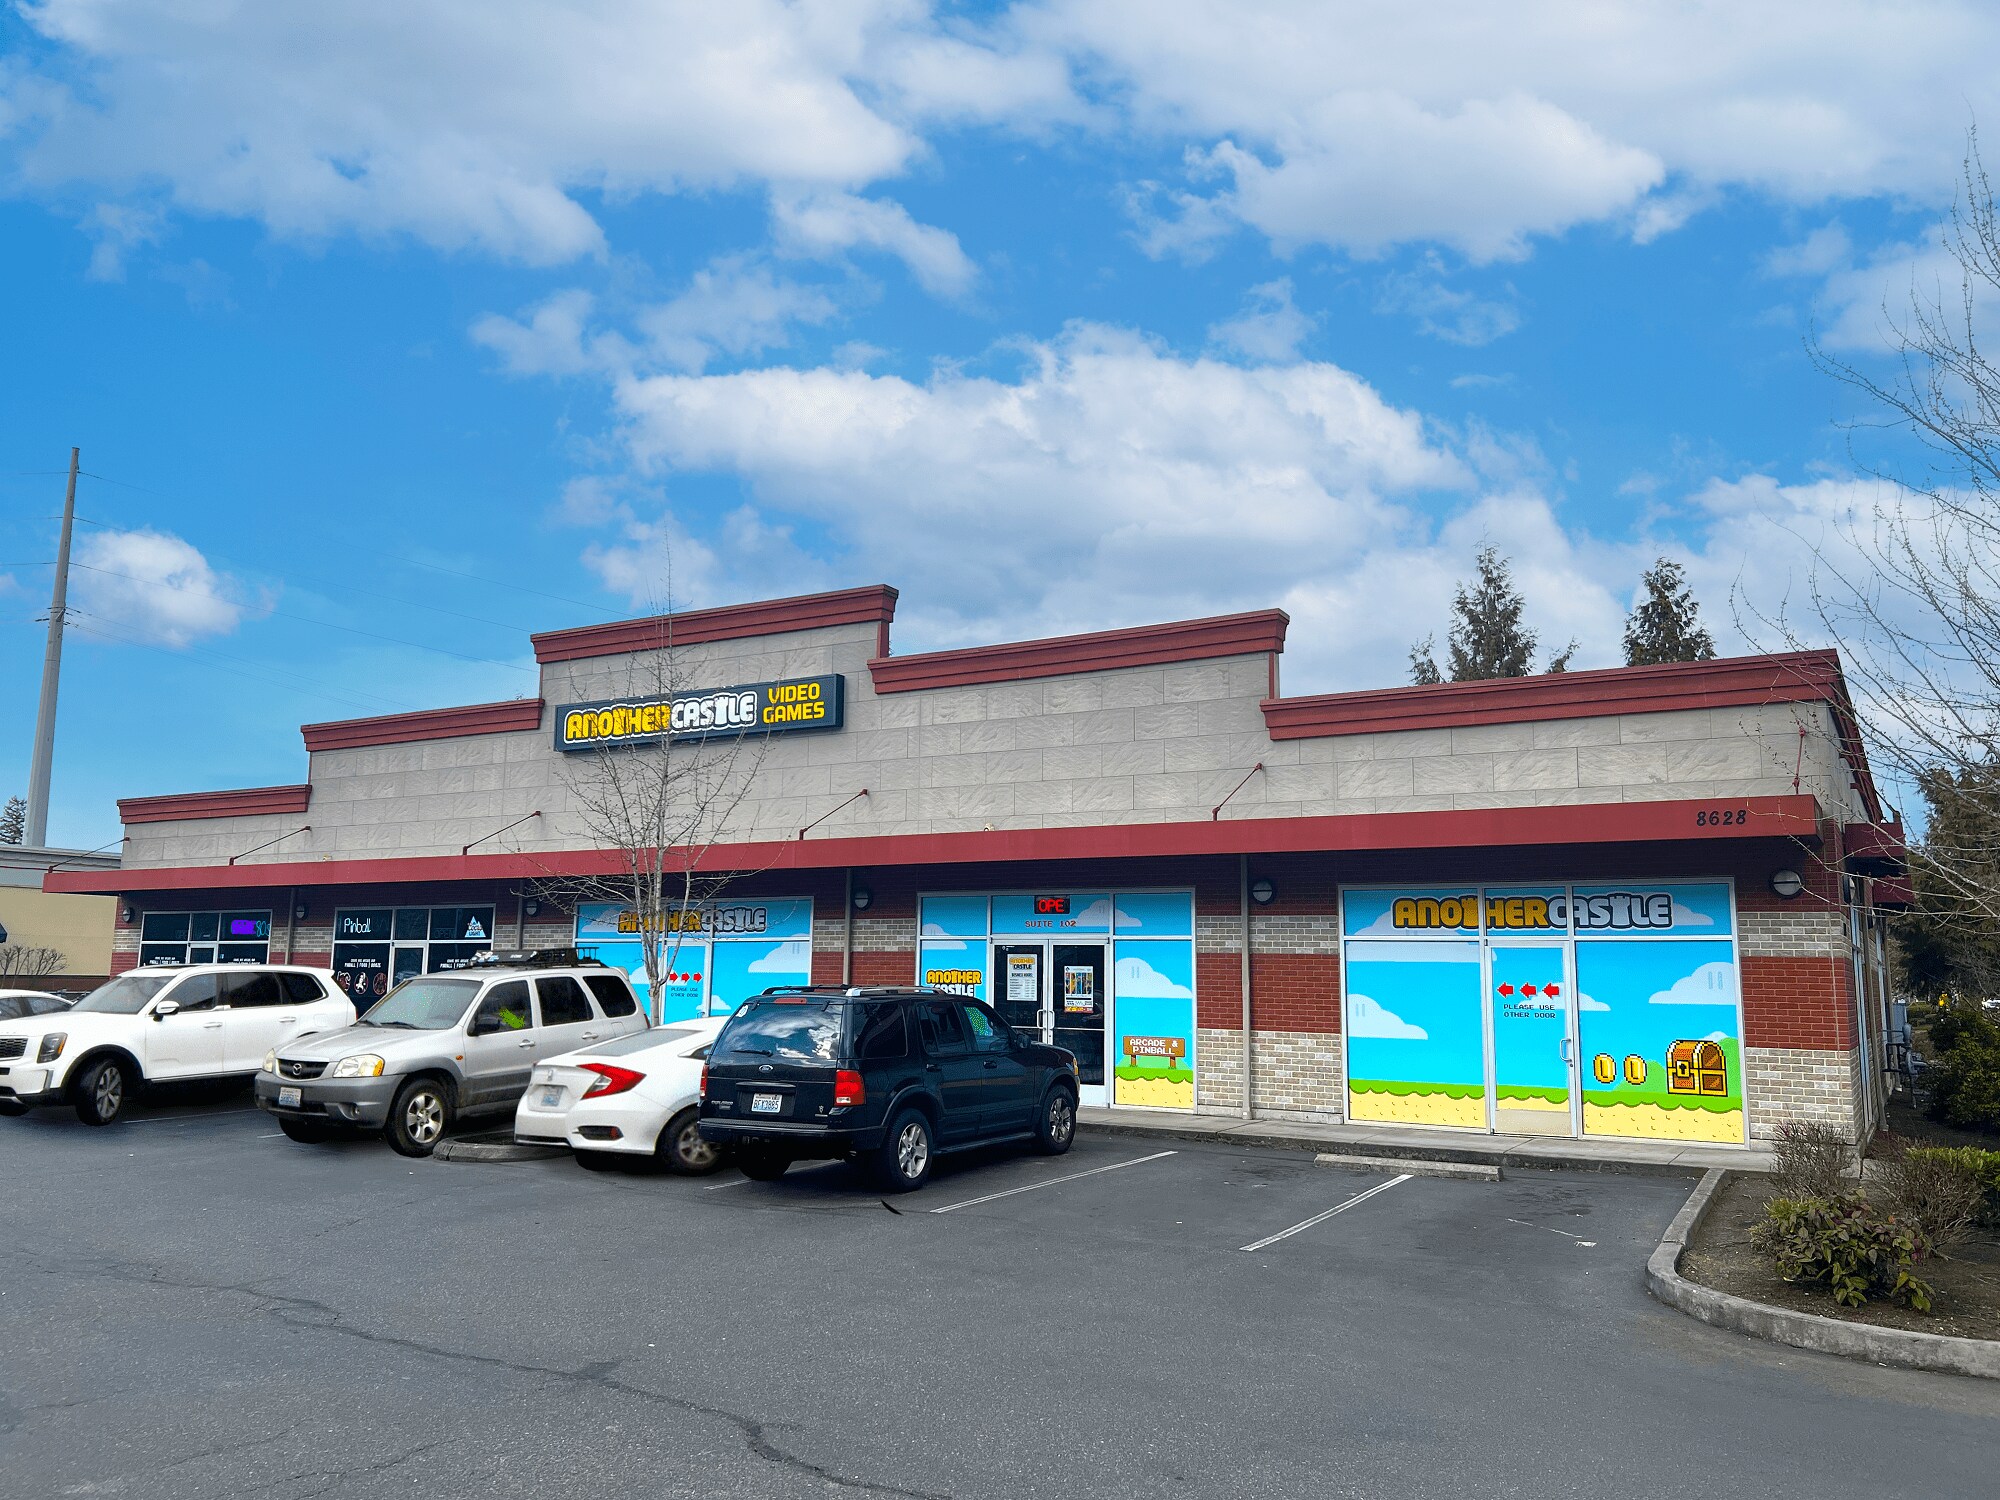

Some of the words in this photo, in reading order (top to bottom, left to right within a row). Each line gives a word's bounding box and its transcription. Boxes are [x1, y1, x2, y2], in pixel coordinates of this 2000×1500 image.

[768, 682, 820, 704] VIDEO
[566, 703, 671, 740] ANOTHER
[671, 694, 756, 729] CASTLE
[763, 701, 825, 724] GAMES
[1696, 809, 1747, 826] 8628
[1394, 896, 1549, 928] ANOTHER
[1548, 894, 1670, 927] CASTLE
[343, 917, 372, 934] Pinball
[701, 909, 767, 932] CASTLE
[1025, 920, 1054, 928] SUITE
[1060, 920, 1077, 928] 102
[926, 969, 982, 984] ANOTHER
[935, 983, 974, 997] ASTLE
[1129, 1038, 1166, 1047] ARCADE
[1171, 1040, 1179, 1048] &
[1132, 1046, 1176, 1055] PINBALL
